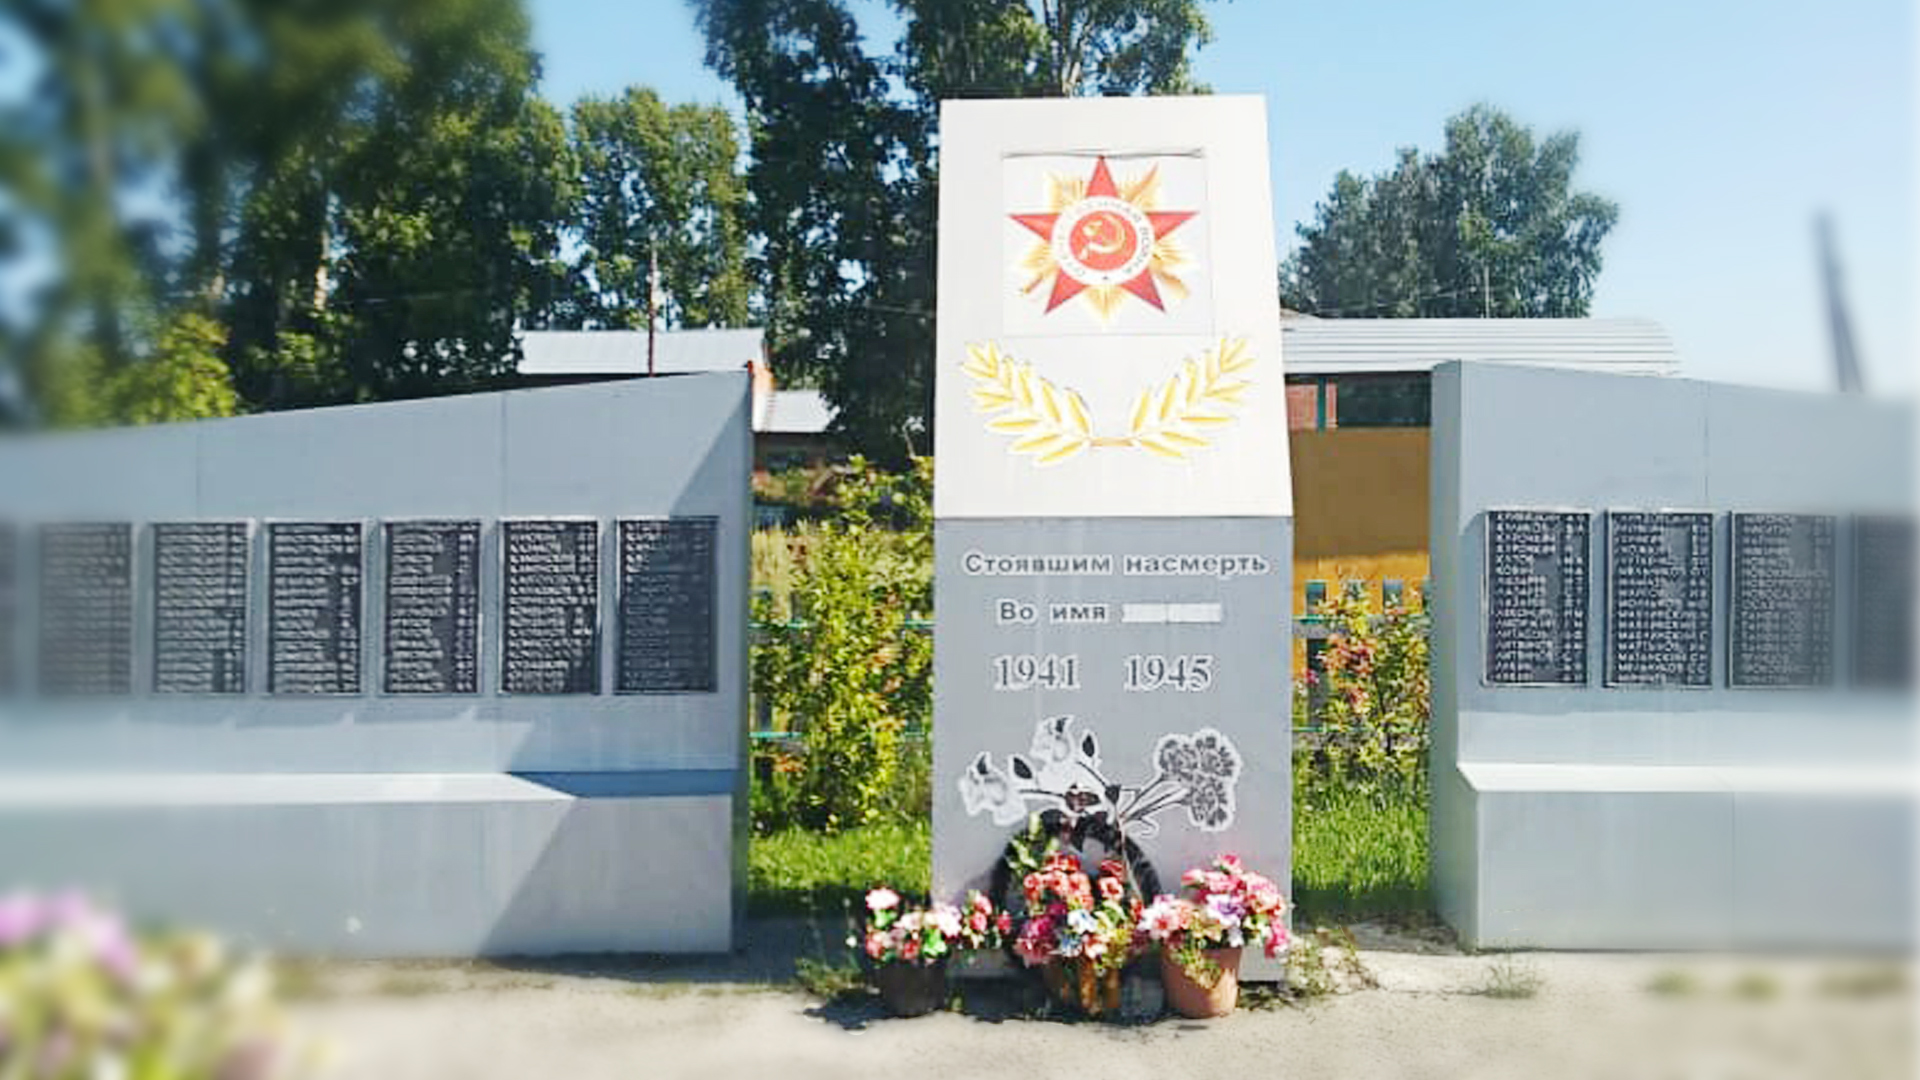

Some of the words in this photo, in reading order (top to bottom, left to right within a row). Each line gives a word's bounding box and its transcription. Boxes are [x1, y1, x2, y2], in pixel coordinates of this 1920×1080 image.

[965, 553, 1111, 576] Стоявшим
[1125, 553, 1267, 579] насмерть
[999, 600, 1035, 622] Во
[1052, 603, 1107, 621] имя
[996, 656, 1079, 688] 1941
[1127, 656, 1212, 688] 1945
